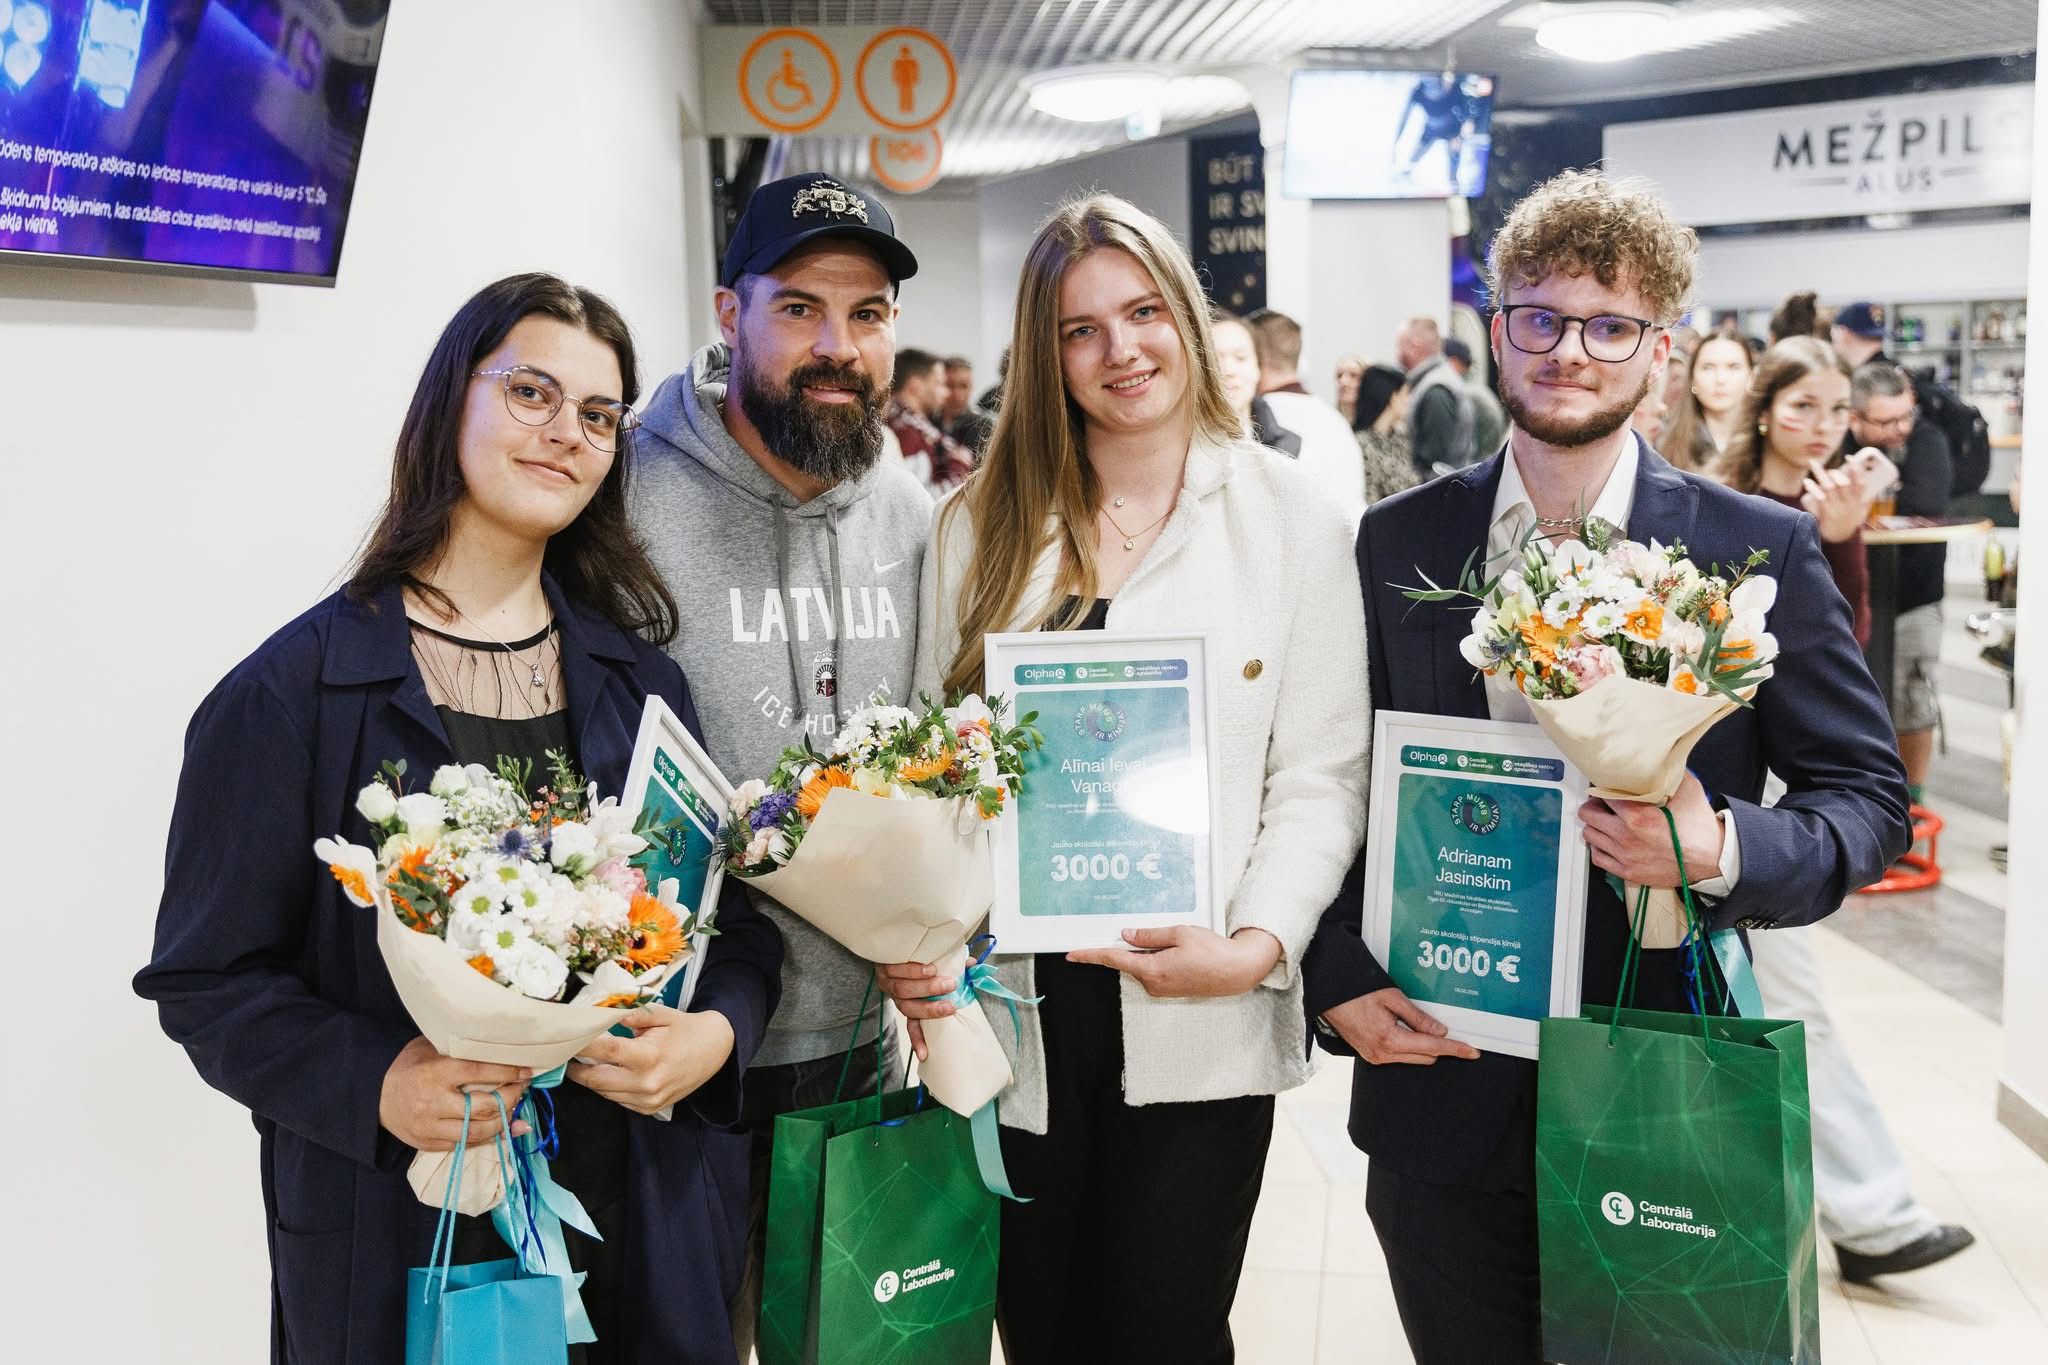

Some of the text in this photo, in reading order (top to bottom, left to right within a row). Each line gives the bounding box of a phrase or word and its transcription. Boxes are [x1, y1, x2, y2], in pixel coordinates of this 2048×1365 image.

[1773, 109, 2018, 170] MEŽPIL
[137, 163, 151, 179] no
[114, 201, 132, 219] kas
[729, 587, 901, 643] LATVIJA
[1024, 668, 1055, 680] Olpha
[753, 677, 892, 735] ICE HOEY
[1060, 758, 1105, 774] Alīnai
[1410, 751, 1439, 763] Olpha
[1451, 795, 1463, 825] STARP
[1466, 793, 1488, 815] MUMS
[1050, 852, 1162, 881] 3000 €
[1437, 846, 1511, 870] Adrianam
[1435, 867, 1511, 891] Jasinskim
[1419, 927, 1440, 936] Jauno
[1417, 940, 1521, 983] 3000 €
[1639, 1200, 1693, 1220] Centrālā
[1640, 1214, 1716, 1238] Laboratorija
[902, 1258, 941, 1280] Centrālā
[902, 1268, 955, 1293] Laboratorija
